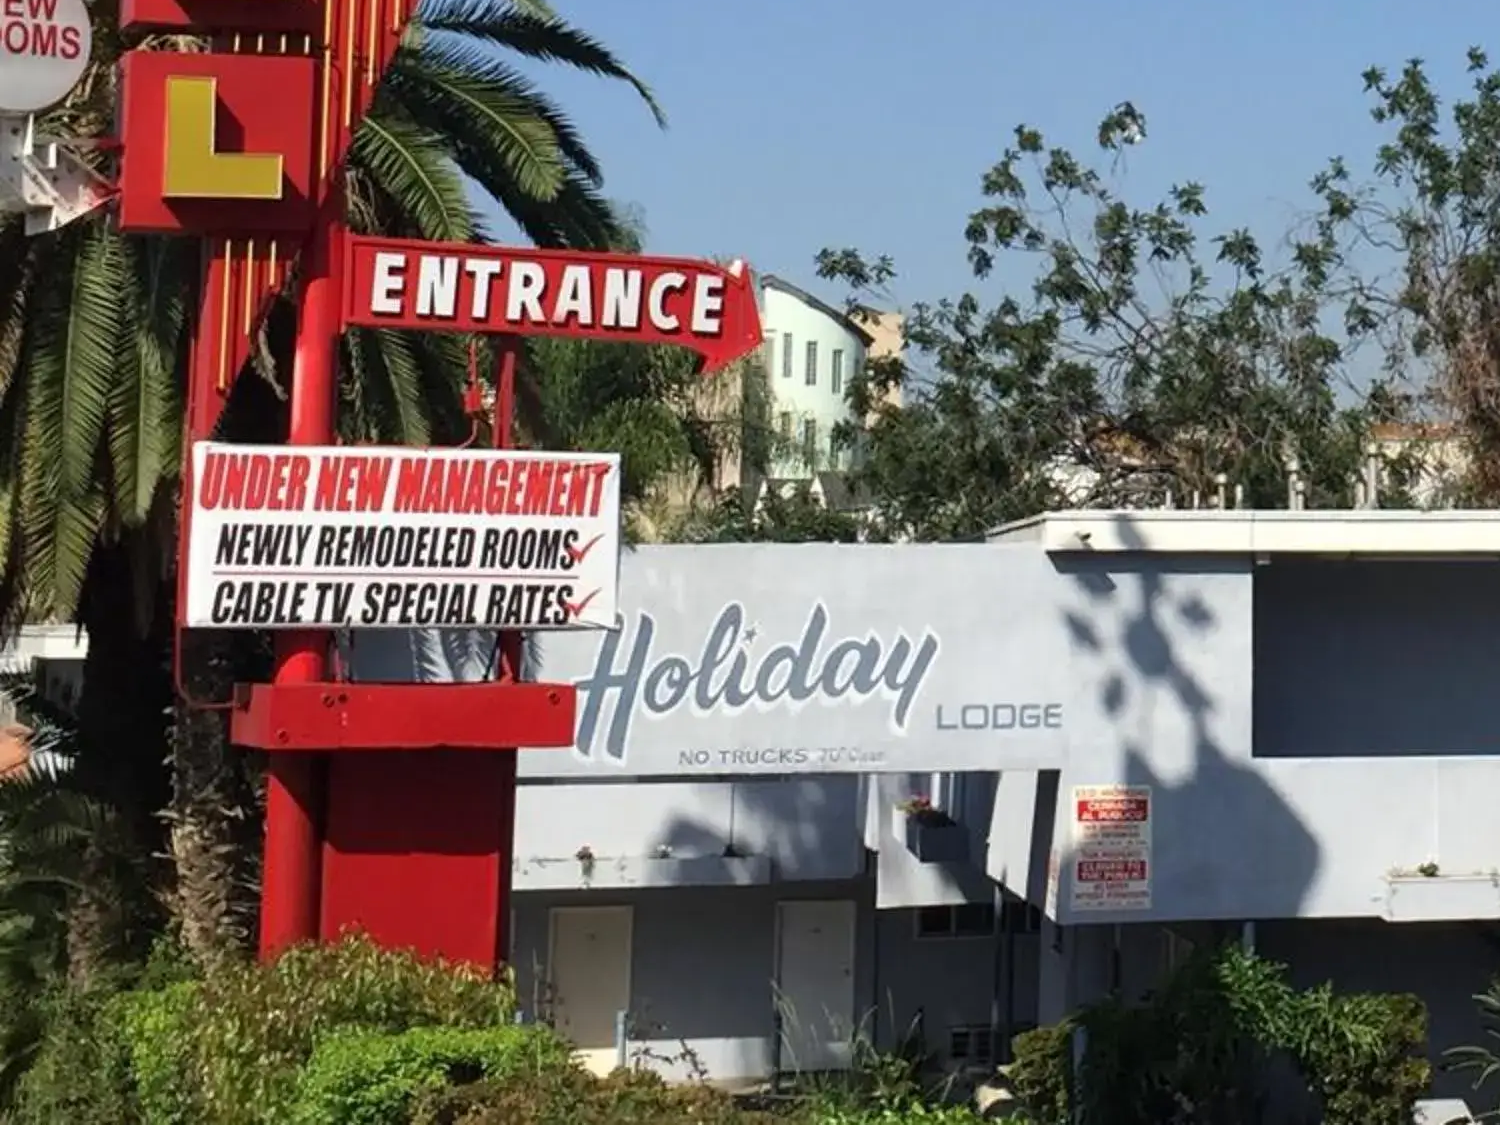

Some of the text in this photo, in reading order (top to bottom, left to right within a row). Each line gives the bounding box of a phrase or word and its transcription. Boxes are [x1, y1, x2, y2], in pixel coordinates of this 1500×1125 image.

[0, 20, 81, 59] OMS
[371, 252, 727, 334] ENTRANCE
[200, 453, 612, 517] UNDER NEW MANAGEMENT
[215, 523, 579, 570] NEWLY REMODELED ROOMS
[211, 580, 308, 624] CABLE
[361, 582, 478, 625] SPECIAL
[484, 584, 573, 625] RATES
[576, 602, 939, 760] Holiday
[936, 703, 1063, 730] LODGE
[679, 749, 710, 765] NO
[719, 748, 809, 764] TRUCKS
